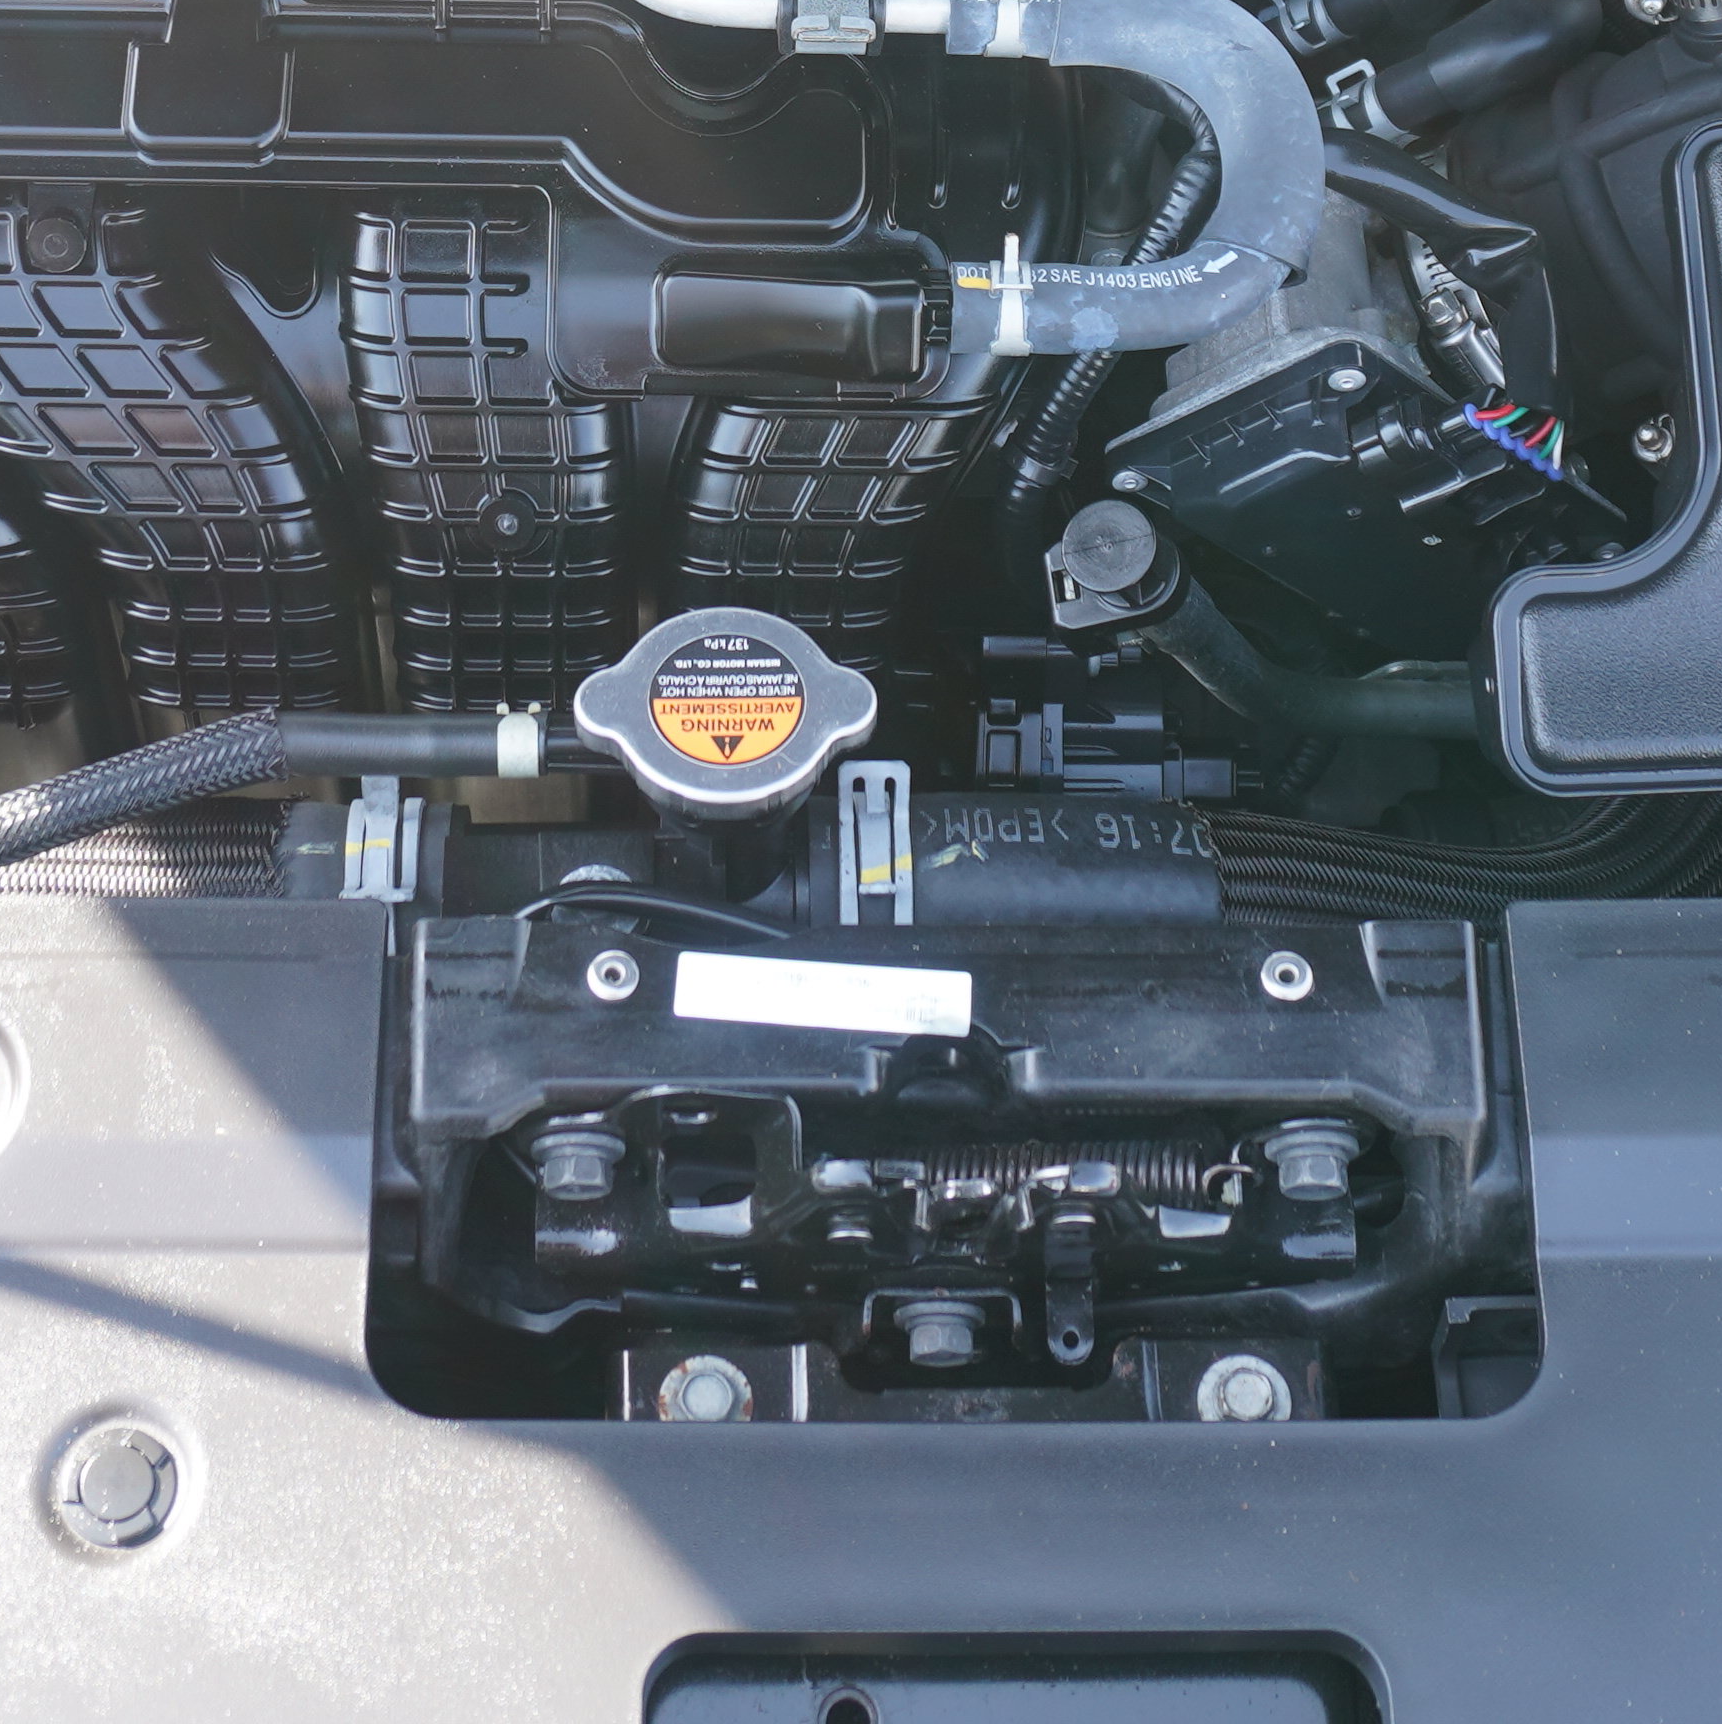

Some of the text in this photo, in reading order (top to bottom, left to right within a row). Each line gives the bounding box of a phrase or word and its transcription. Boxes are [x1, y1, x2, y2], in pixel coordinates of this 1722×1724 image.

[1050, 269, 1082, 284] SAE
[1086, 271, 1137, 289] J1403
[1140, 265, 1203, 289] ENGINE
[703, 637, 749, 651] 137 kPa
[712, 658, 745, 668] MOTOR
[747, 658, 781, 668] NISSAN
[705, 674, 745, 685] OUVRIR
[747, 673, 783, 685] JAMAIS
[783, 673, 798, 684] NE
[660, 686, 796, 697] NEVER OPEN WHEN HOT.
[659, 701, 796, 715] AVERTISSEMENT
[681, 718, 775, 732] WARNING
